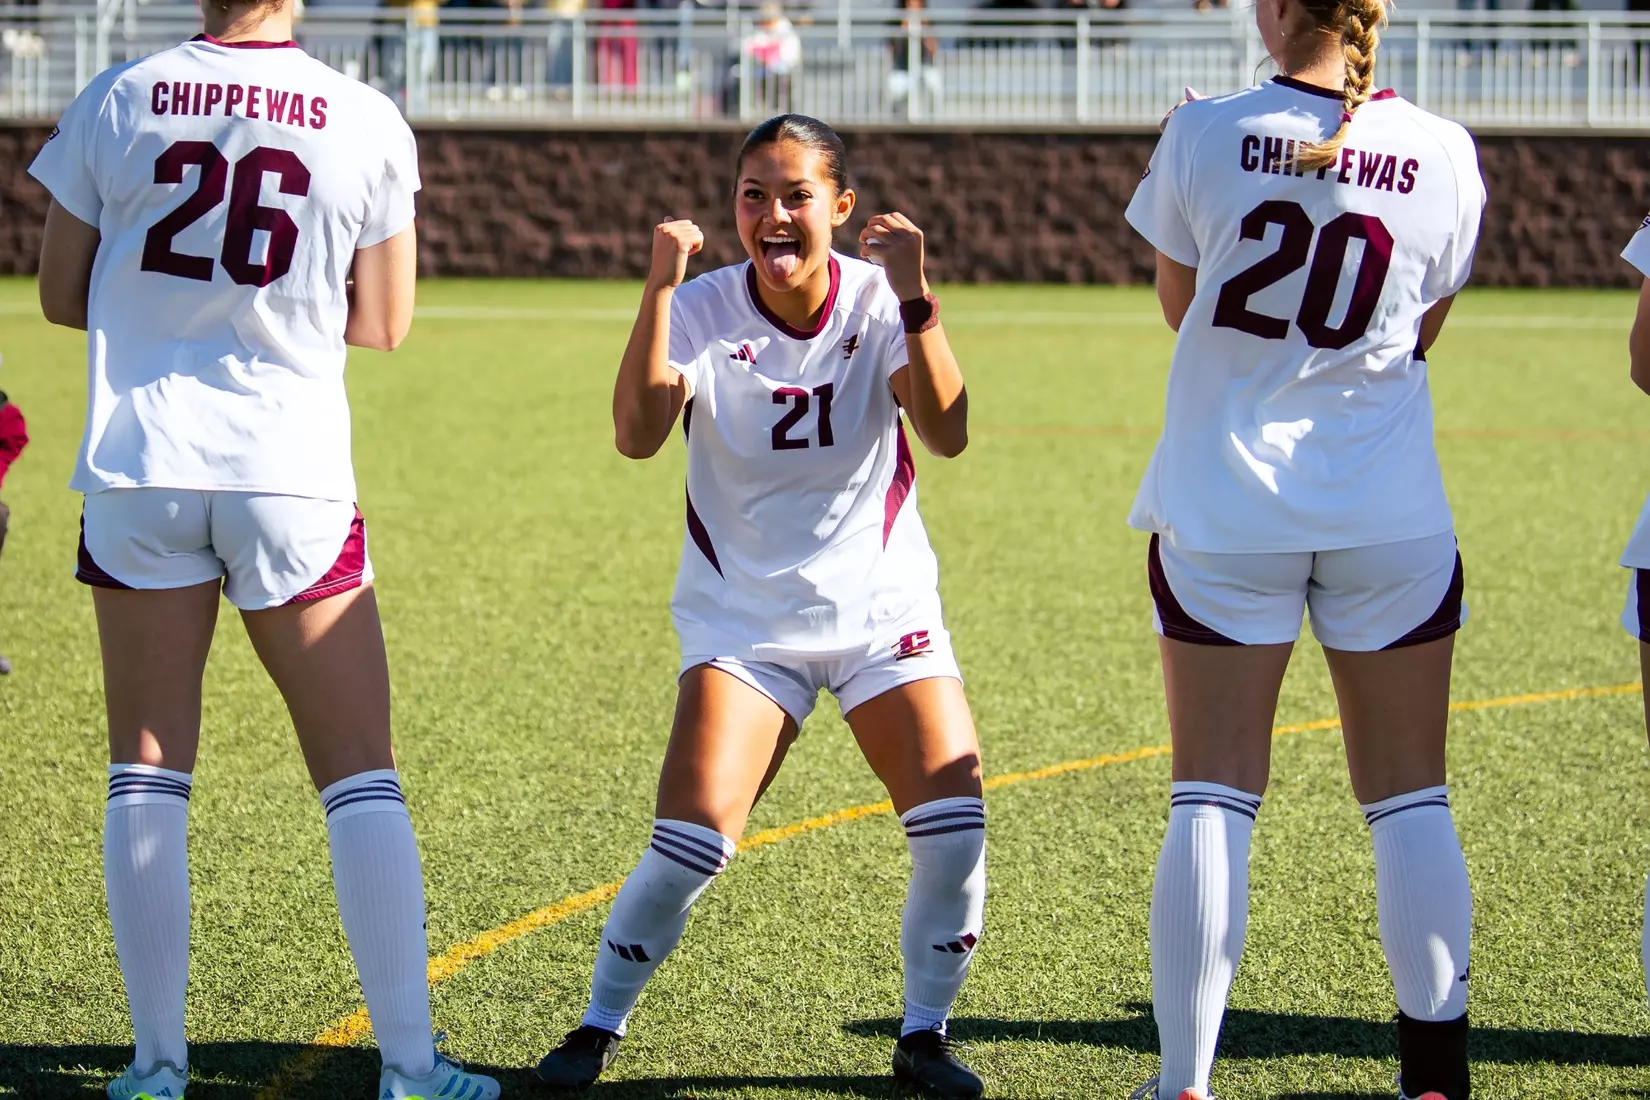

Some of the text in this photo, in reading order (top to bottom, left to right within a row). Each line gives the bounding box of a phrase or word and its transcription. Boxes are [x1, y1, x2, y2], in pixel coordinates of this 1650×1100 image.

[152, 81, 328, 129] CHIPPEWAS
[141, 140, 311, 288] 26
[1212, 200, 1394, 350] 20
[771, 382, 834, 450] 21
